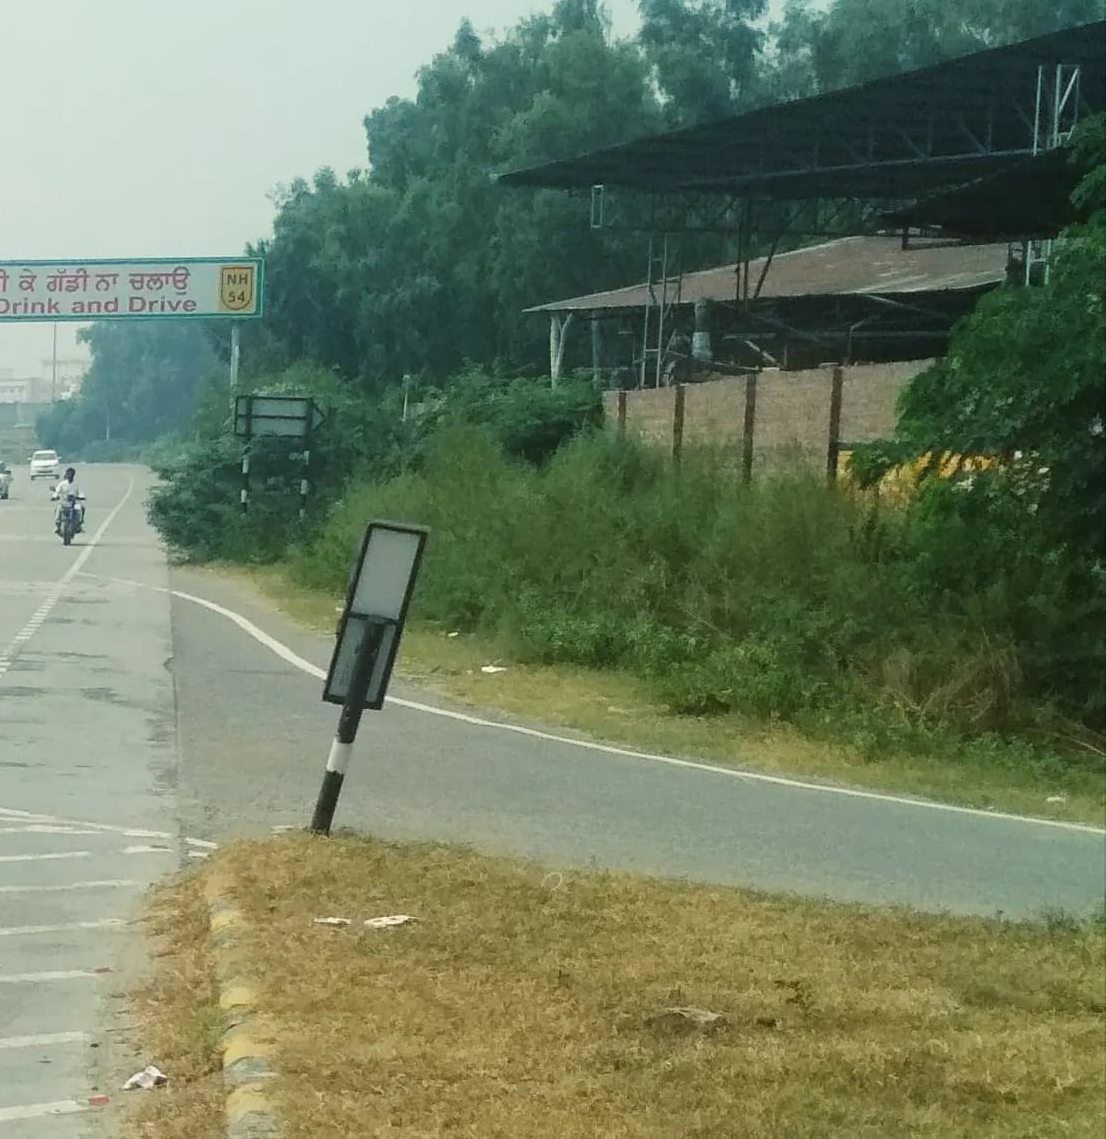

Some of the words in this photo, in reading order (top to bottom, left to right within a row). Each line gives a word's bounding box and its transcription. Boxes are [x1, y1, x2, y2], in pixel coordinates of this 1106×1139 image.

[18, 268, 37, 292] ਕੇ
[46, 268, 90, 293] ਗੱਡੀ
[95, 273, 119, 292] ਨਾ
[227, 274, 248, 285] NH
[228, 291, 245, 302] 54
[71, 297, 118, 314] and
[129, 295, 197, 312] Drive
